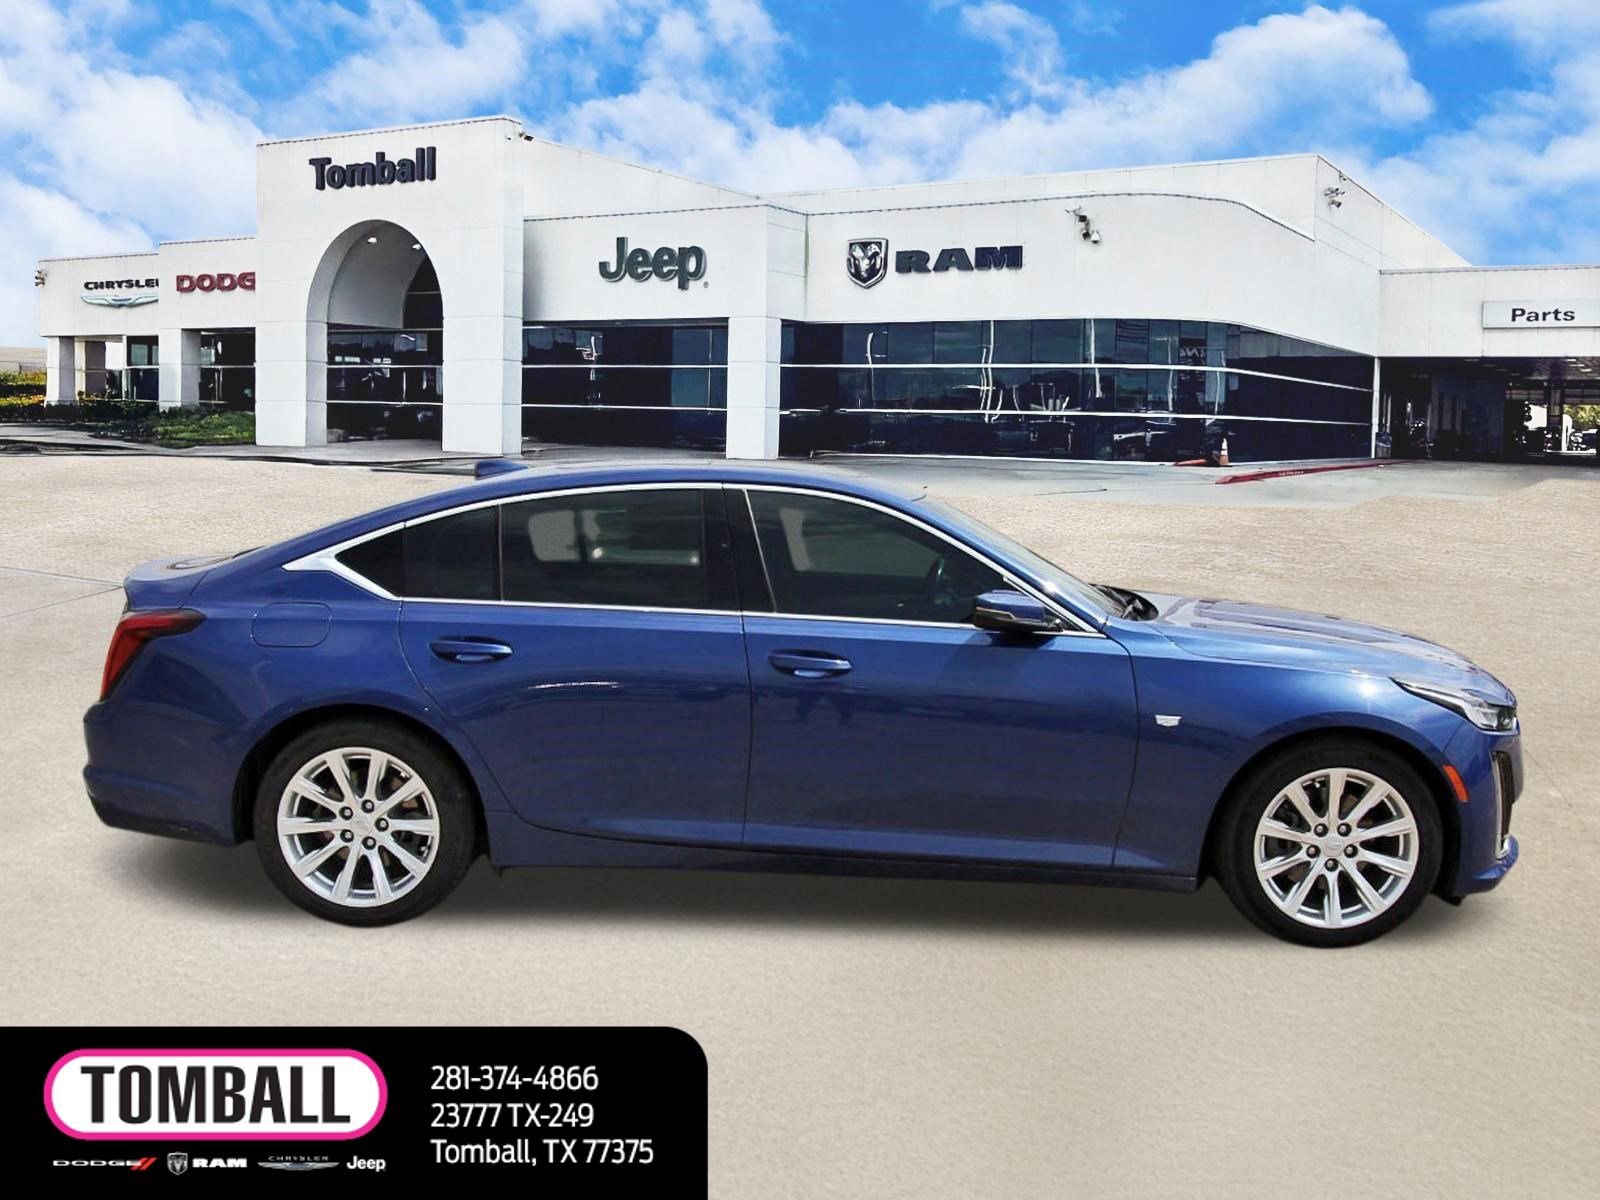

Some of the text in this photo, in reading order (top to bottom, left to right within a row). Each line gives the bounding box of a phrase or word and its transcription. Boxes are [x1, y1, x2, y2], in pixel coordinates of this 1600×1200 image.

[309, 146, 437, 190] Tomball
[599, 237, 707, 290] Jeep
[896, 246, 1023, 273] RAM
[84, 279, 159, 290] CHRYSLE
[1511, 307, 1576, 322] Parts
